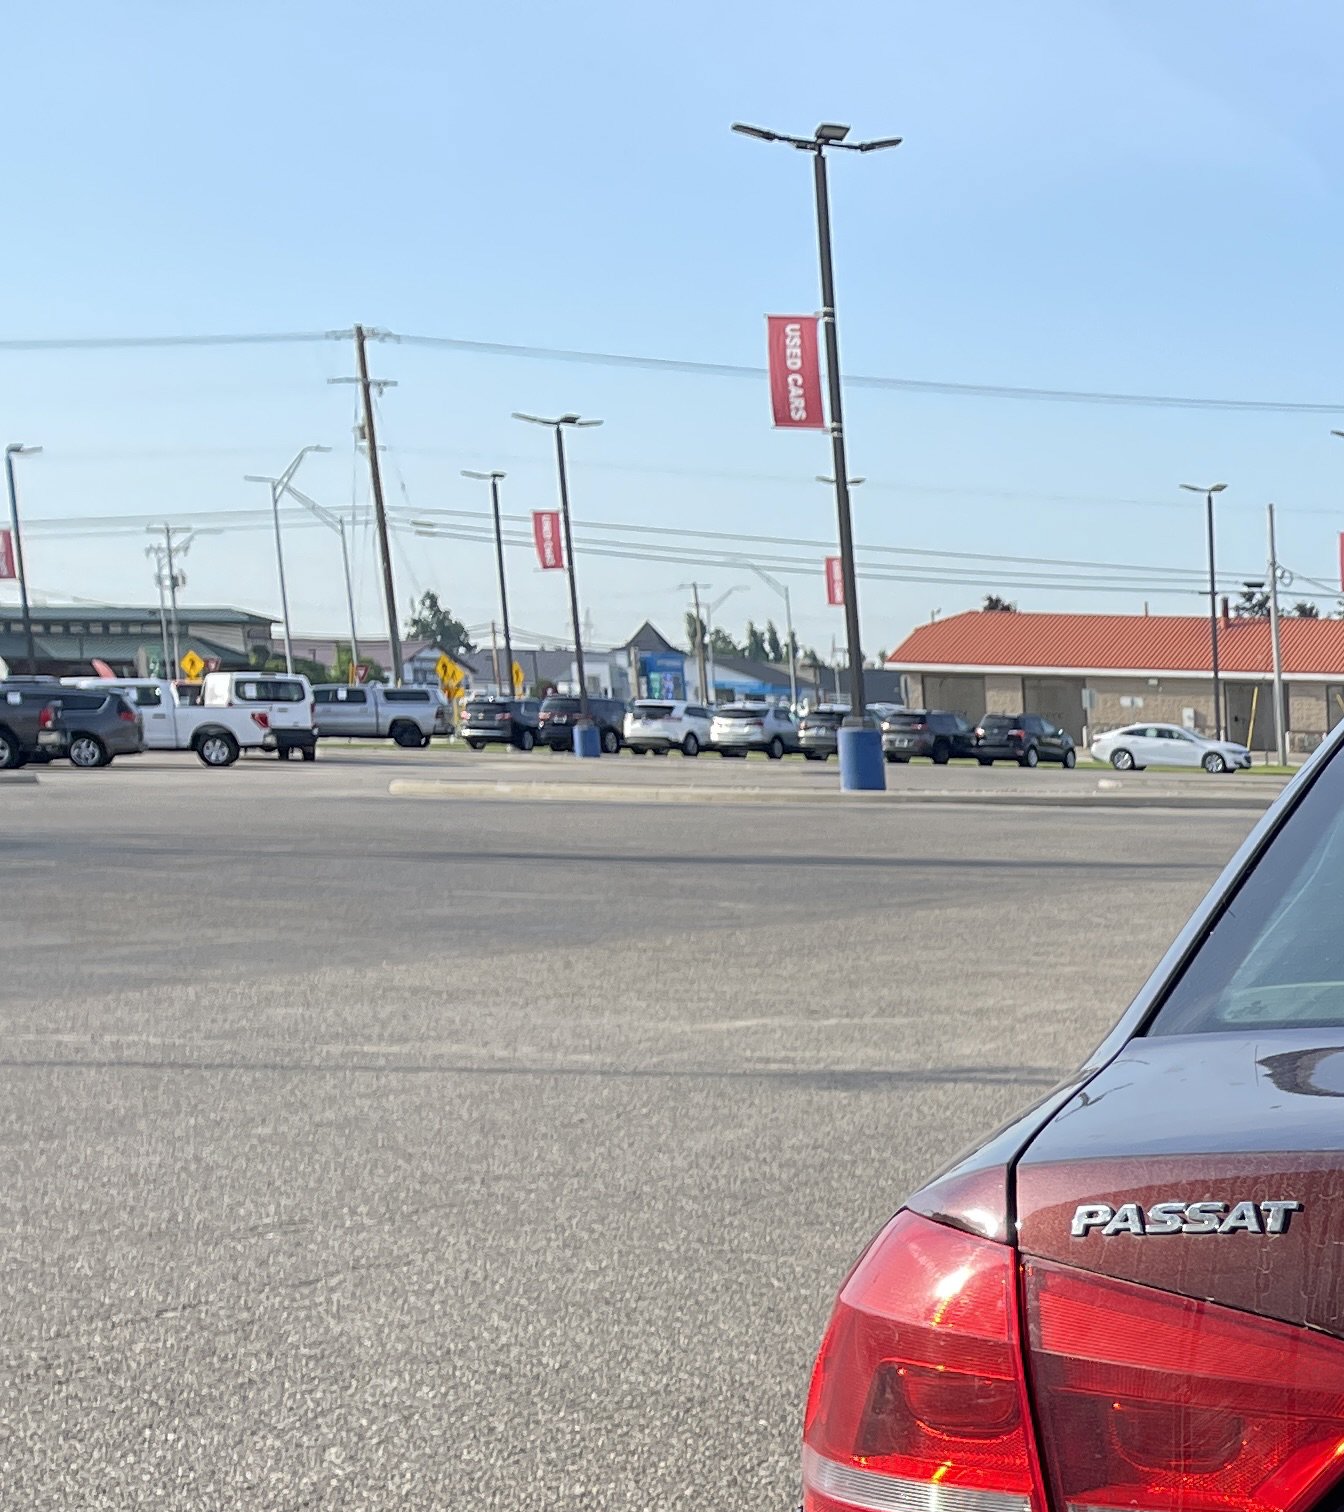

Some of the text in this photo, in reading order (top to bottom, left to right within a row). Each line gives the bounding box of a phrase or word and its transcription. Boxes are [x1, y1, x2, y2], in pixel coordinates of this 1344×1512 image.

[785, 323, 806, 421] USED CARS
[1071, 1201, 1301, 1237] PASSAT
